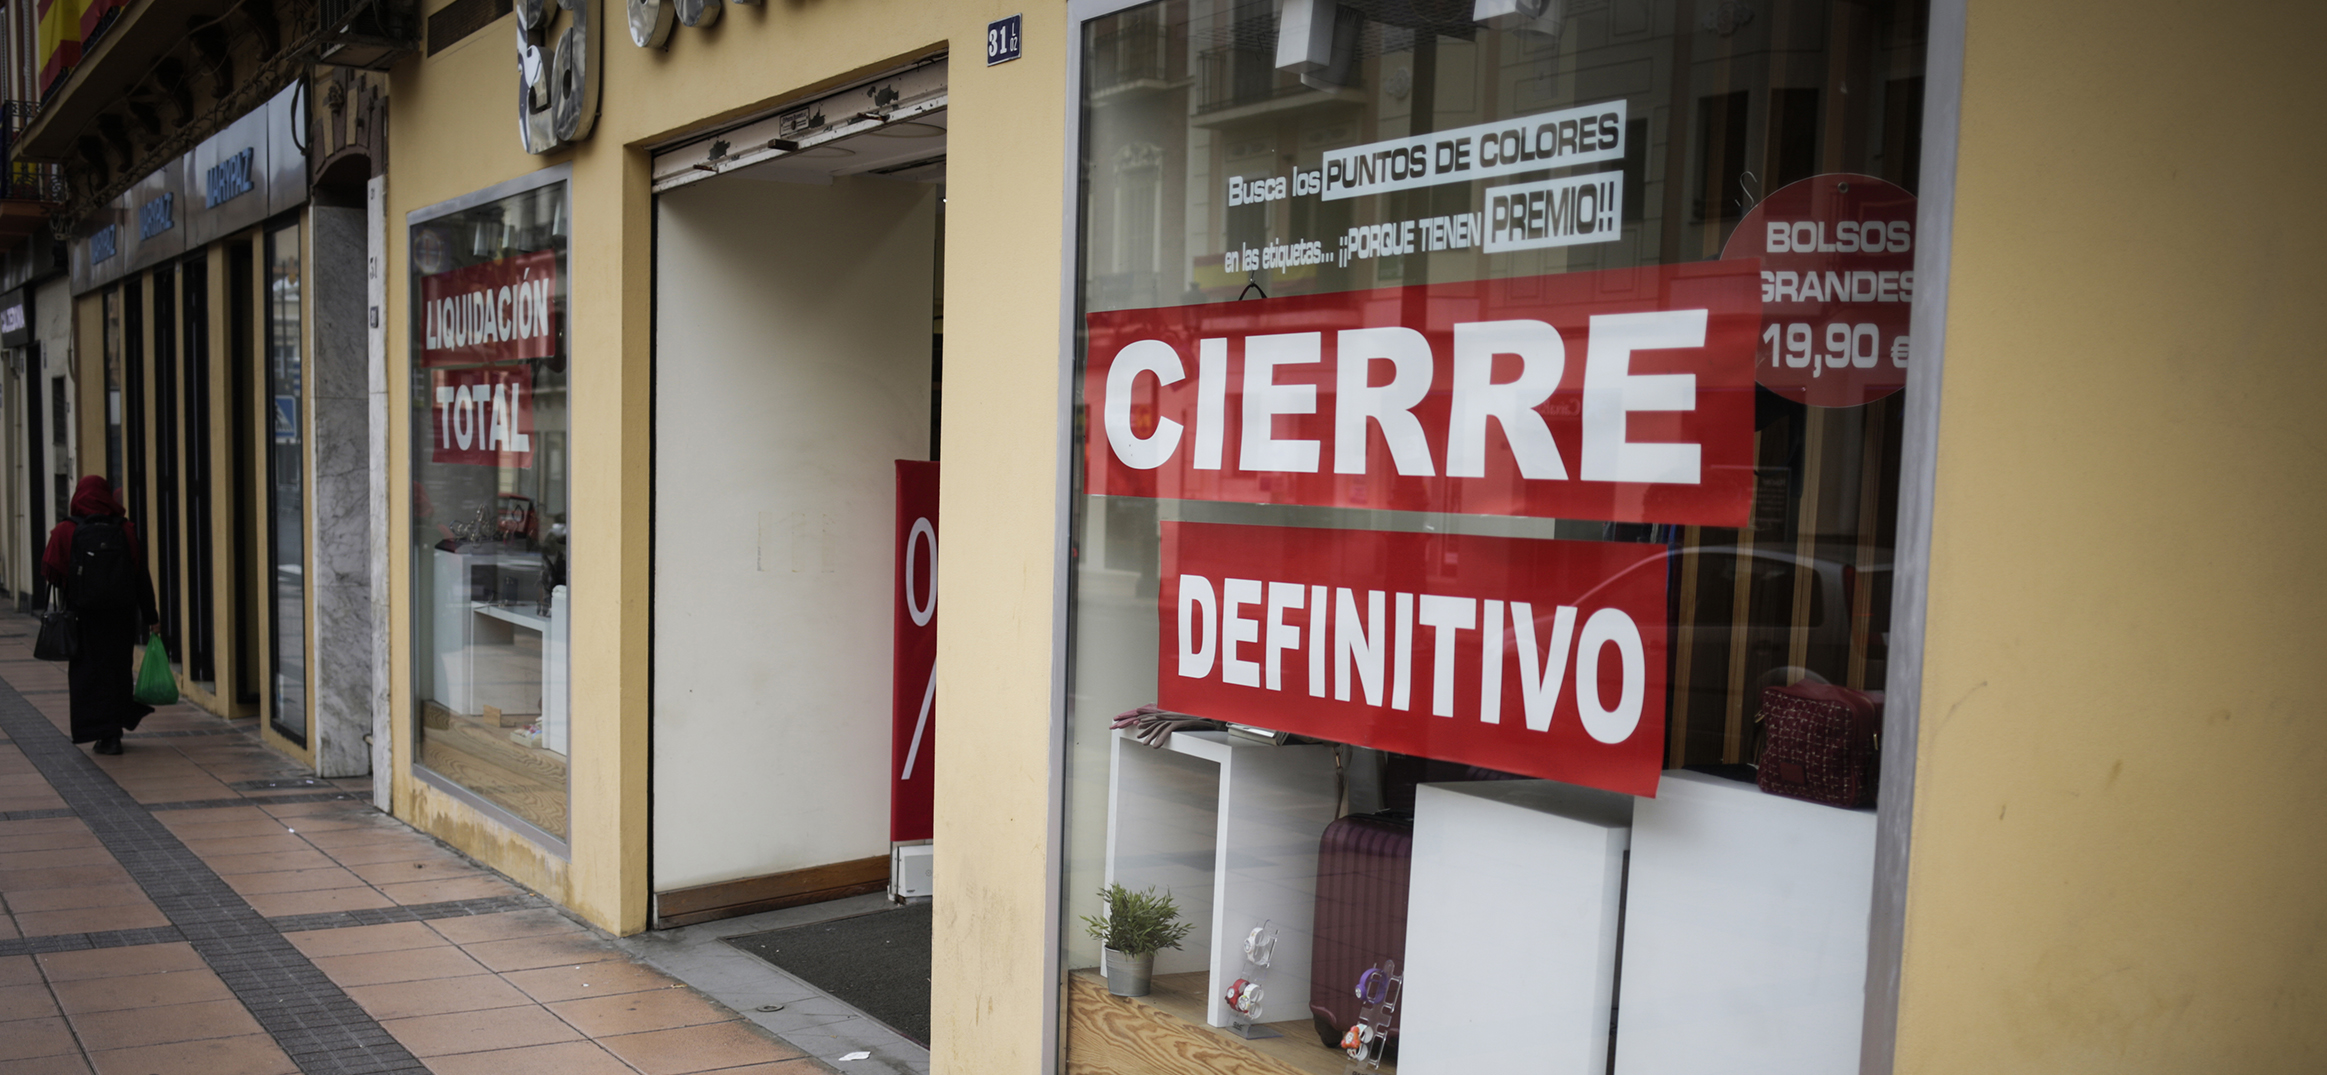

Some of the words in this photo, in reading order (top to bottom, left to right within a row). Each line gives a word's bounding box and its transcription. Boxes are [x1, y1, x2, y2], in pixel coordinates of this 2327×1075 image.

[988, 25, 1007, 57] 31
[206, 147, 254, 210] MARYPAZ
[1228, 175, 1287, 207] Busca
[1292, 165, 1321, 197] los
[1326, 144, 1427, 192] PUNTOS
[1435, 136, 1471, 174] DE
[1479, 112, 1620, 169] COLORES
[1224, 248, 1239, 274] en
[1241, 241, 1259, 272] las
[1262, 236, 1334, 275] etiquetas...
[1419, 211, 1482, 252] TIENEN
[1491, 181, 1615, 244] PREMIO!!
[1766, 220, 1911, 253] BOLSOS
[426, 267, 549, 352] LIQUIDACIÓN
[1760, 270, 1914, 303] GRANDES
[1762, 322, 1880, 378] 19,90
[1890, 335, 1910, 369] €
[436, 382, 530, 453] TOTAL
[1104, 308, 1709, 485] CIERRE
[1177, 573, 1646, 745] DEFINITIVO
